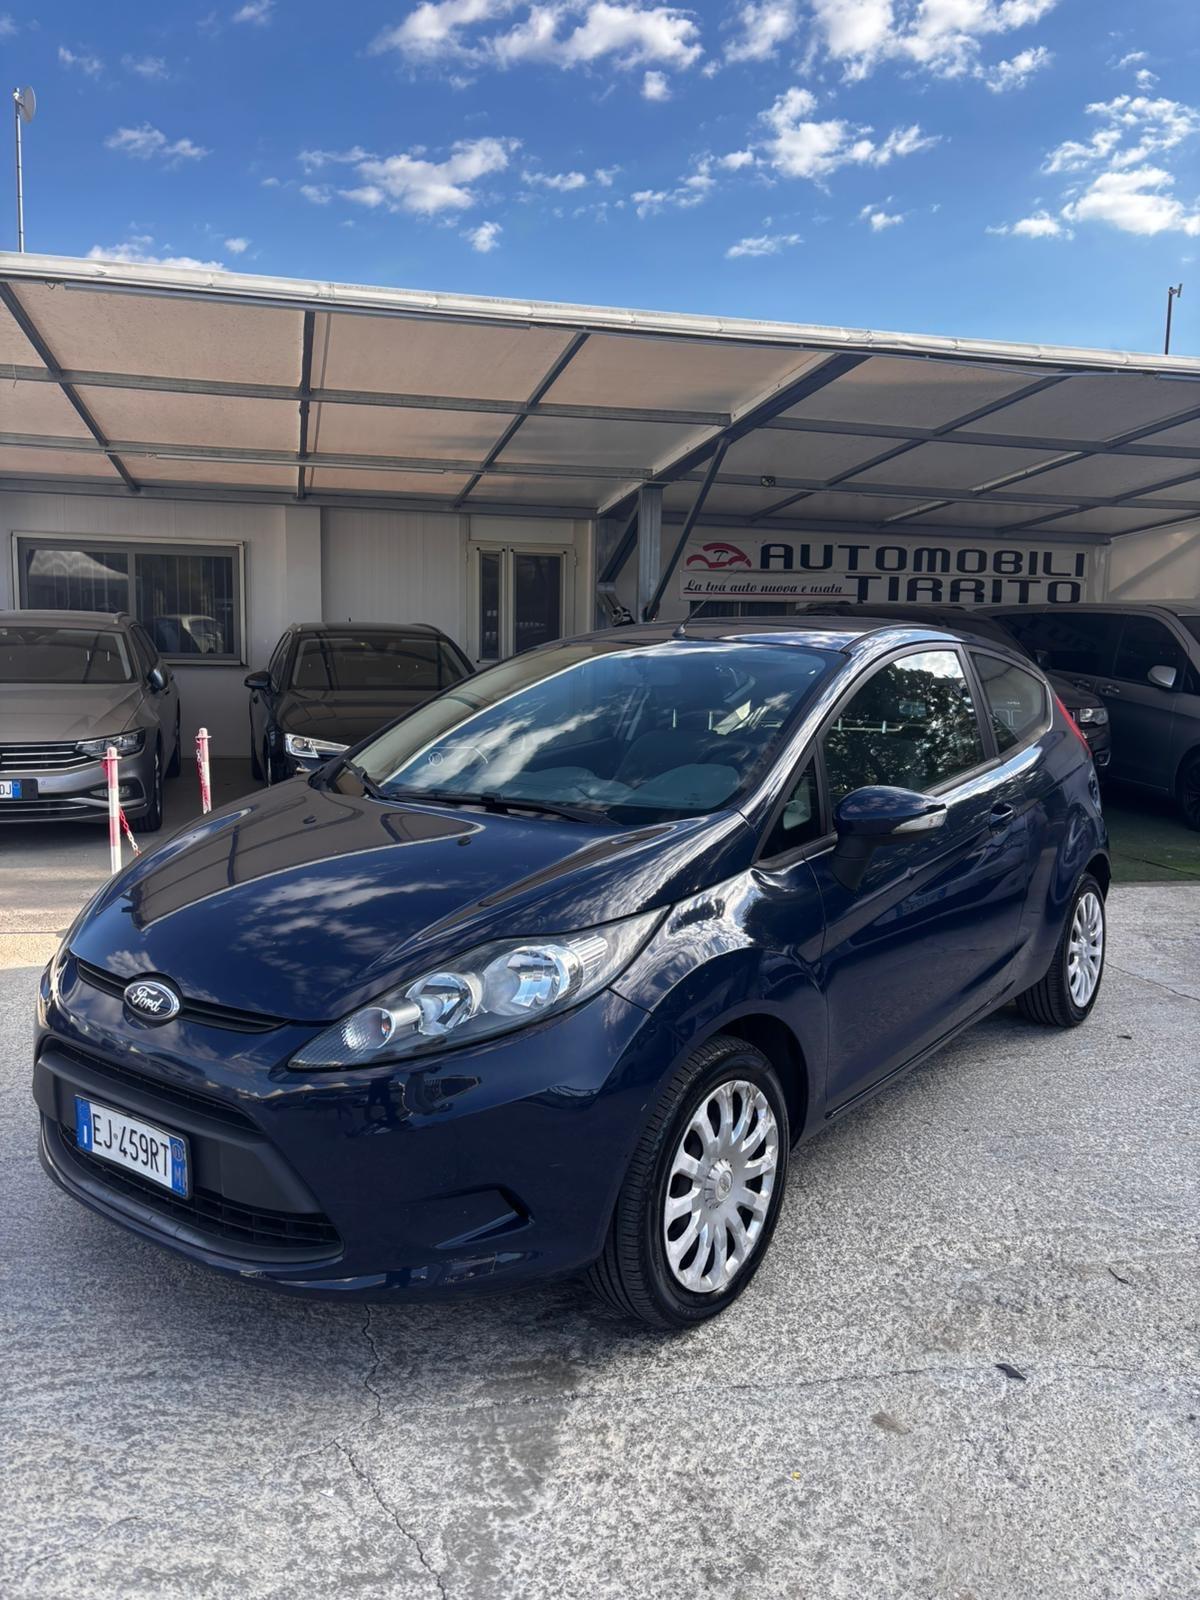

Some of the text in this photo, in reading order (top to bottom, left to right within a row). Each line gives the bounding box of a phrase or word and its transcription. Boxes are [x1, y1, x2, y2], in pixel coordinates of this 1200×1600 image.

[760, 543, 1085, 577] AUTOMOBILI
[684, 579, 702, 591] La
[730, 582, 757, 592] auto
[760, 584, 797, 593] nuova
[801, 585, 807, 593] e
[810, 584, 842, 593] usata
[845, 575, 1081, 604] TIRRITO
[131, 986, 163, 1012] Ford
